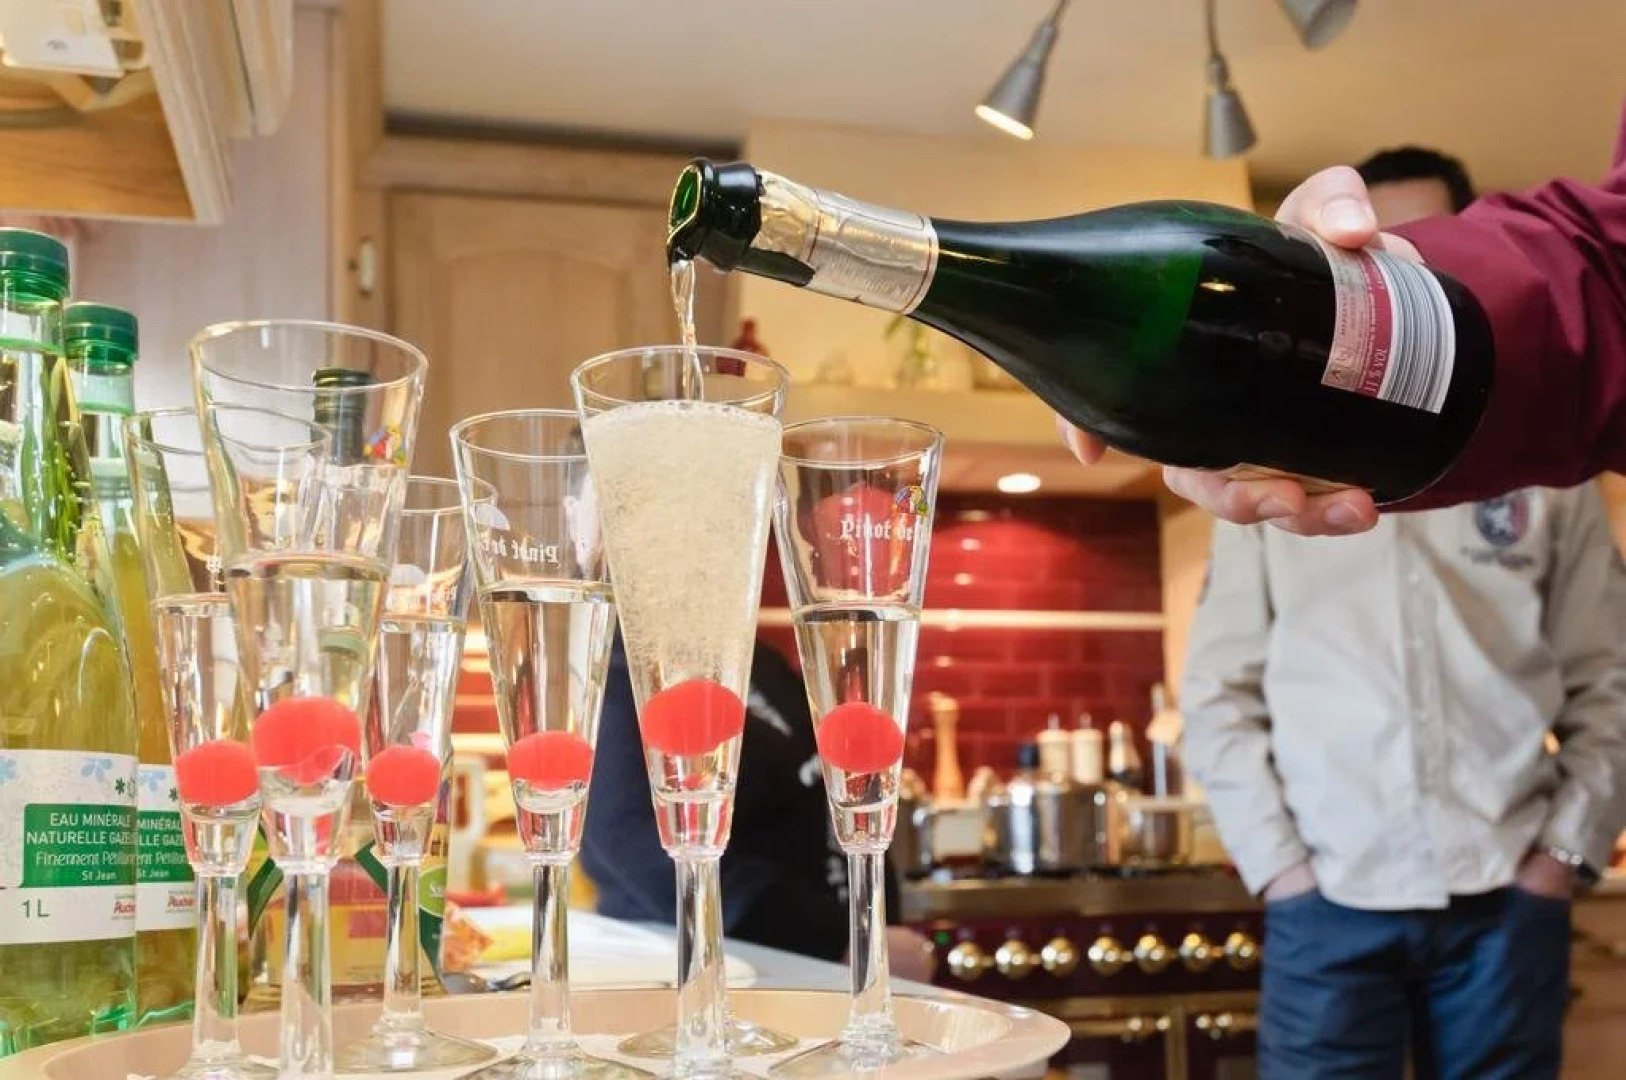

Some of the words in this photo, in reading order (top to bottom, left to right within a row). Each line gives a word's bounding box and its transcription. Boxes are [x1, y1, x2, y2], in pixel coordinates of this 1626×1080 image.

[840, 513, 892, 542] Pinot
[50, 812, 79, 827] EAU
[82, 809, 132, 828] MINÉRALE
[26, 830, 107, 846] NATURELLE
[81, 870, 92, 882] St
[96, 870, 117, 881] Jean
